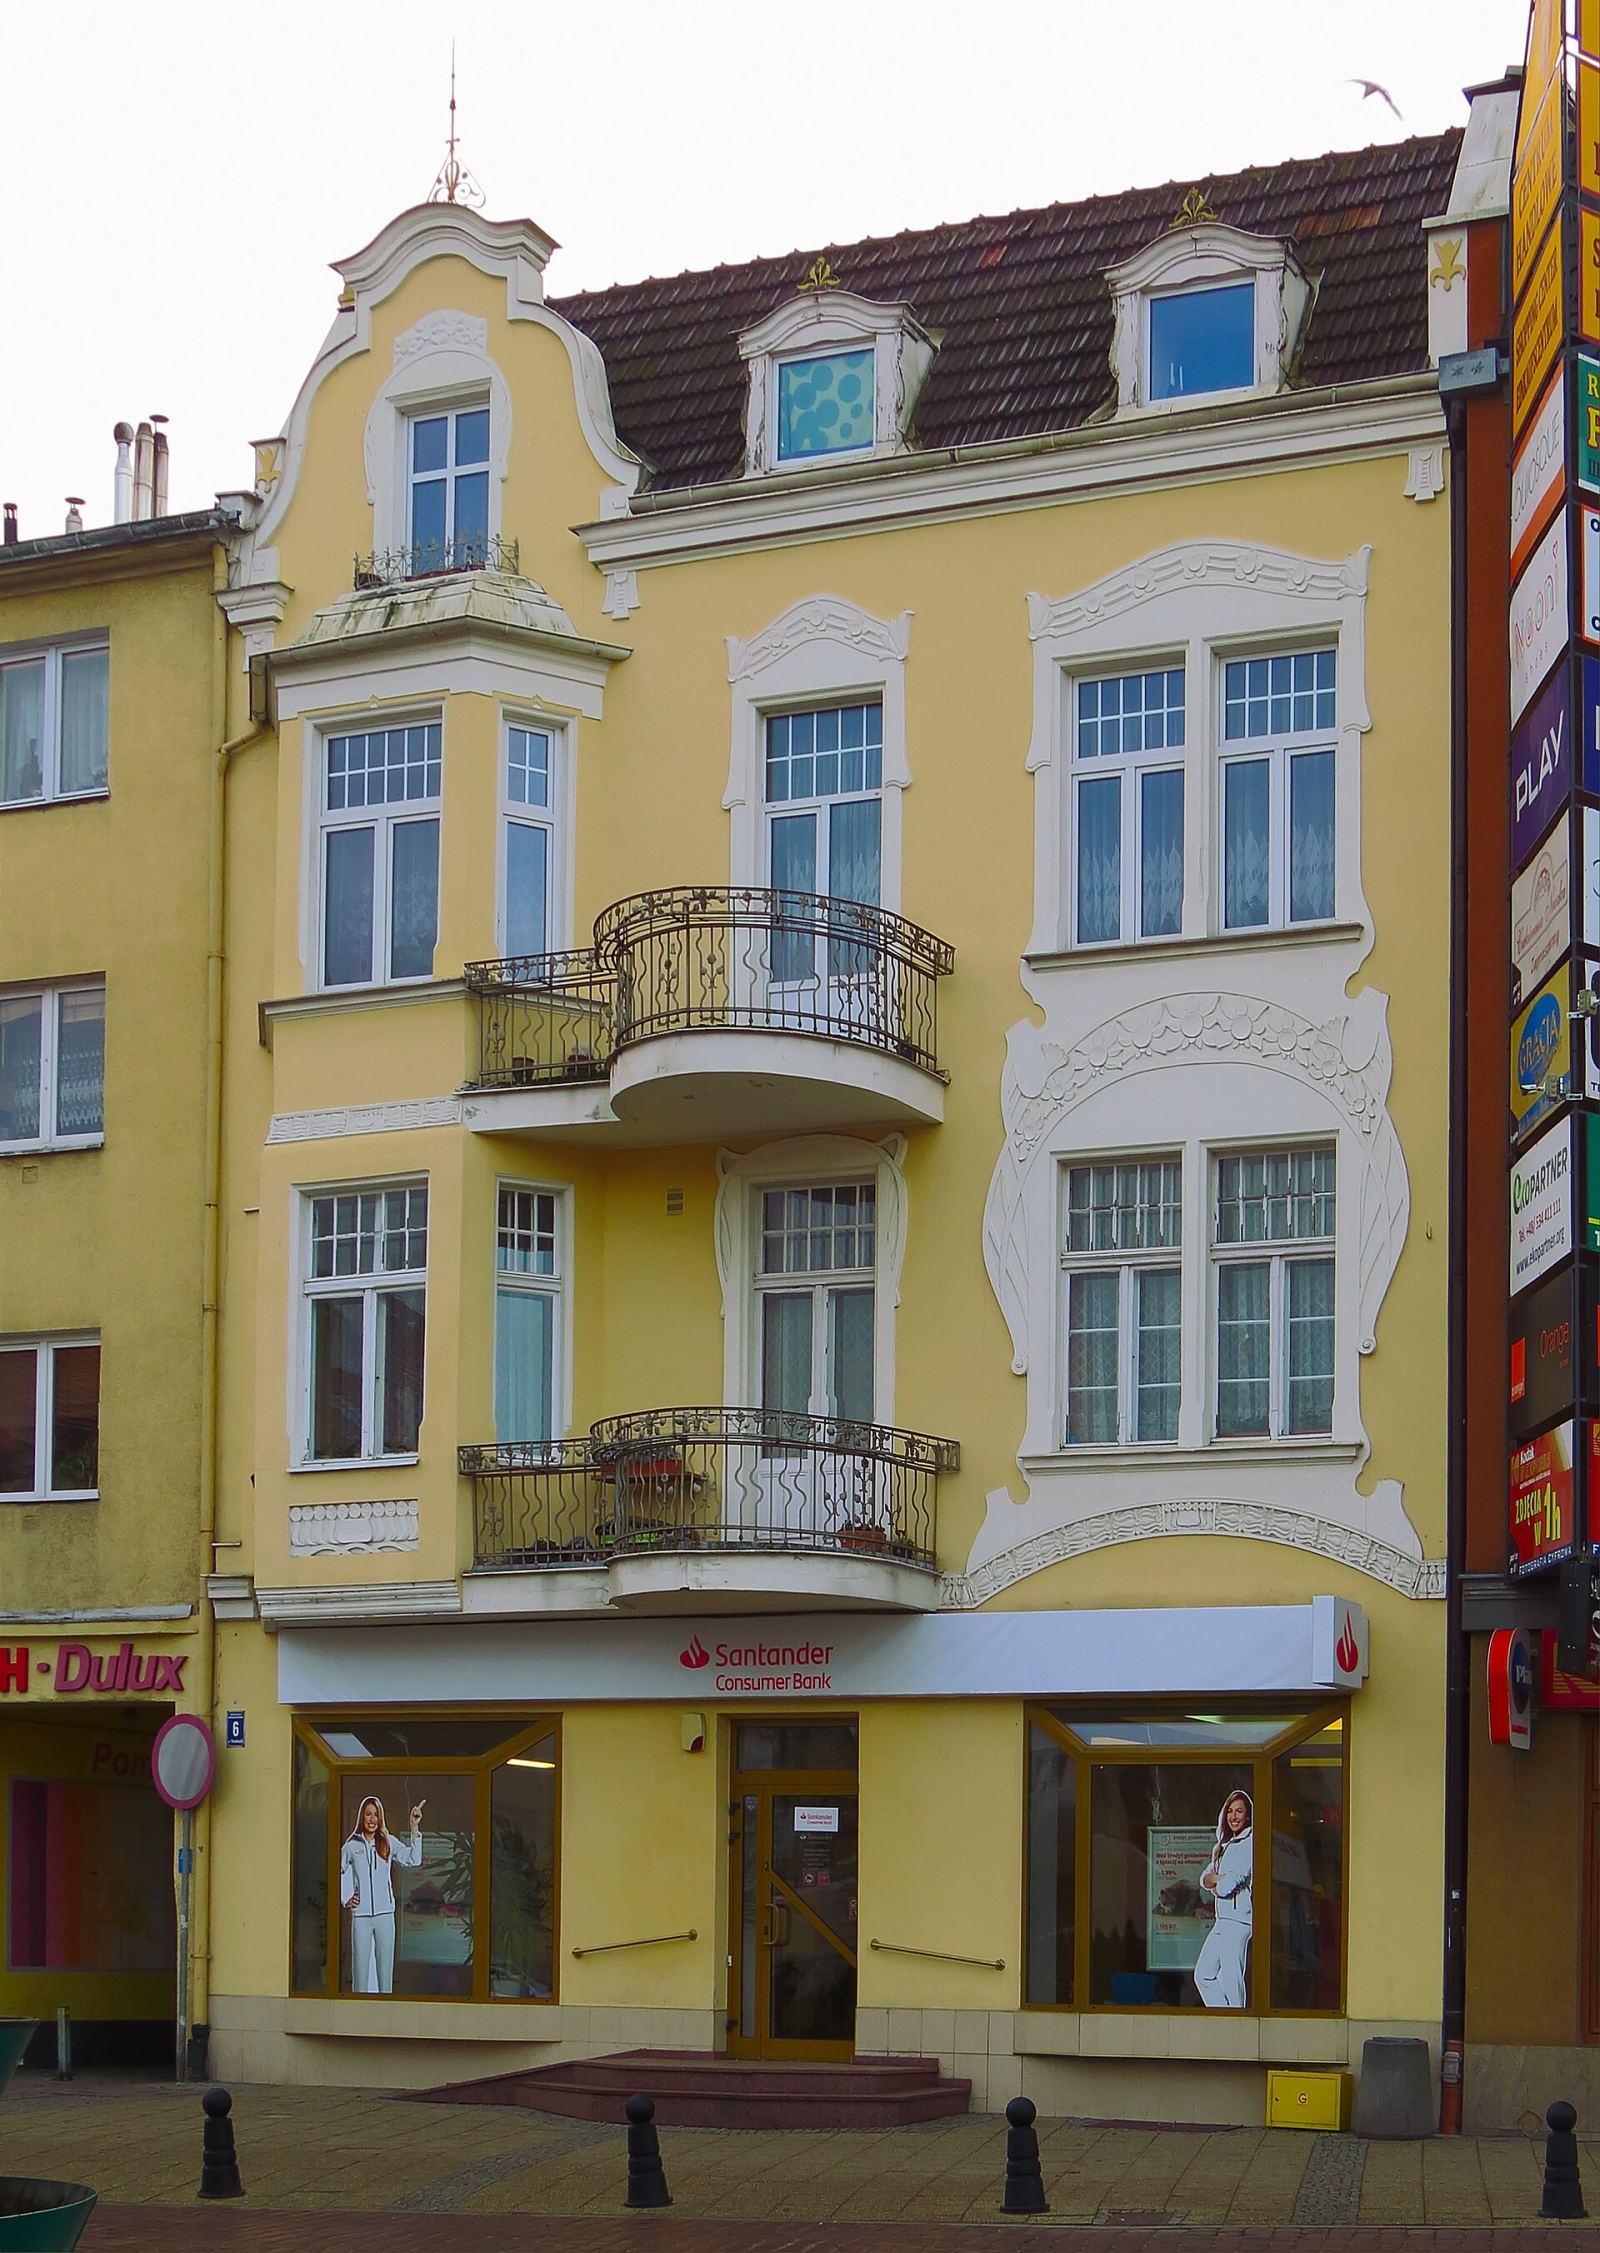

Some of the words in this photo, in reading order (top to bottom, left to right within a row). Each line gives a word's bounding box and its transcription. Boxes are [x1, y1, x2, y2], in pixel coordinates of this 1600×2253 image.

[1516, 709, 1564, 823] PLAY
[1516, 1227, 1565, 1275] www.ekopartner.org
[1541, 1322, 1569, 1358] Orange
[1544, 1482, 1561, 1541] 1h
[54, 1642, 189, 1692] Dulux
[715, 1641, 834, 1667] Santander
[716, 1674, 791, 1691] Consumer
[793, 1672, 832, 1689] Bank
[233, 1721, 239, 1737] 6
[1298, 2092, 1308, 2104] G
